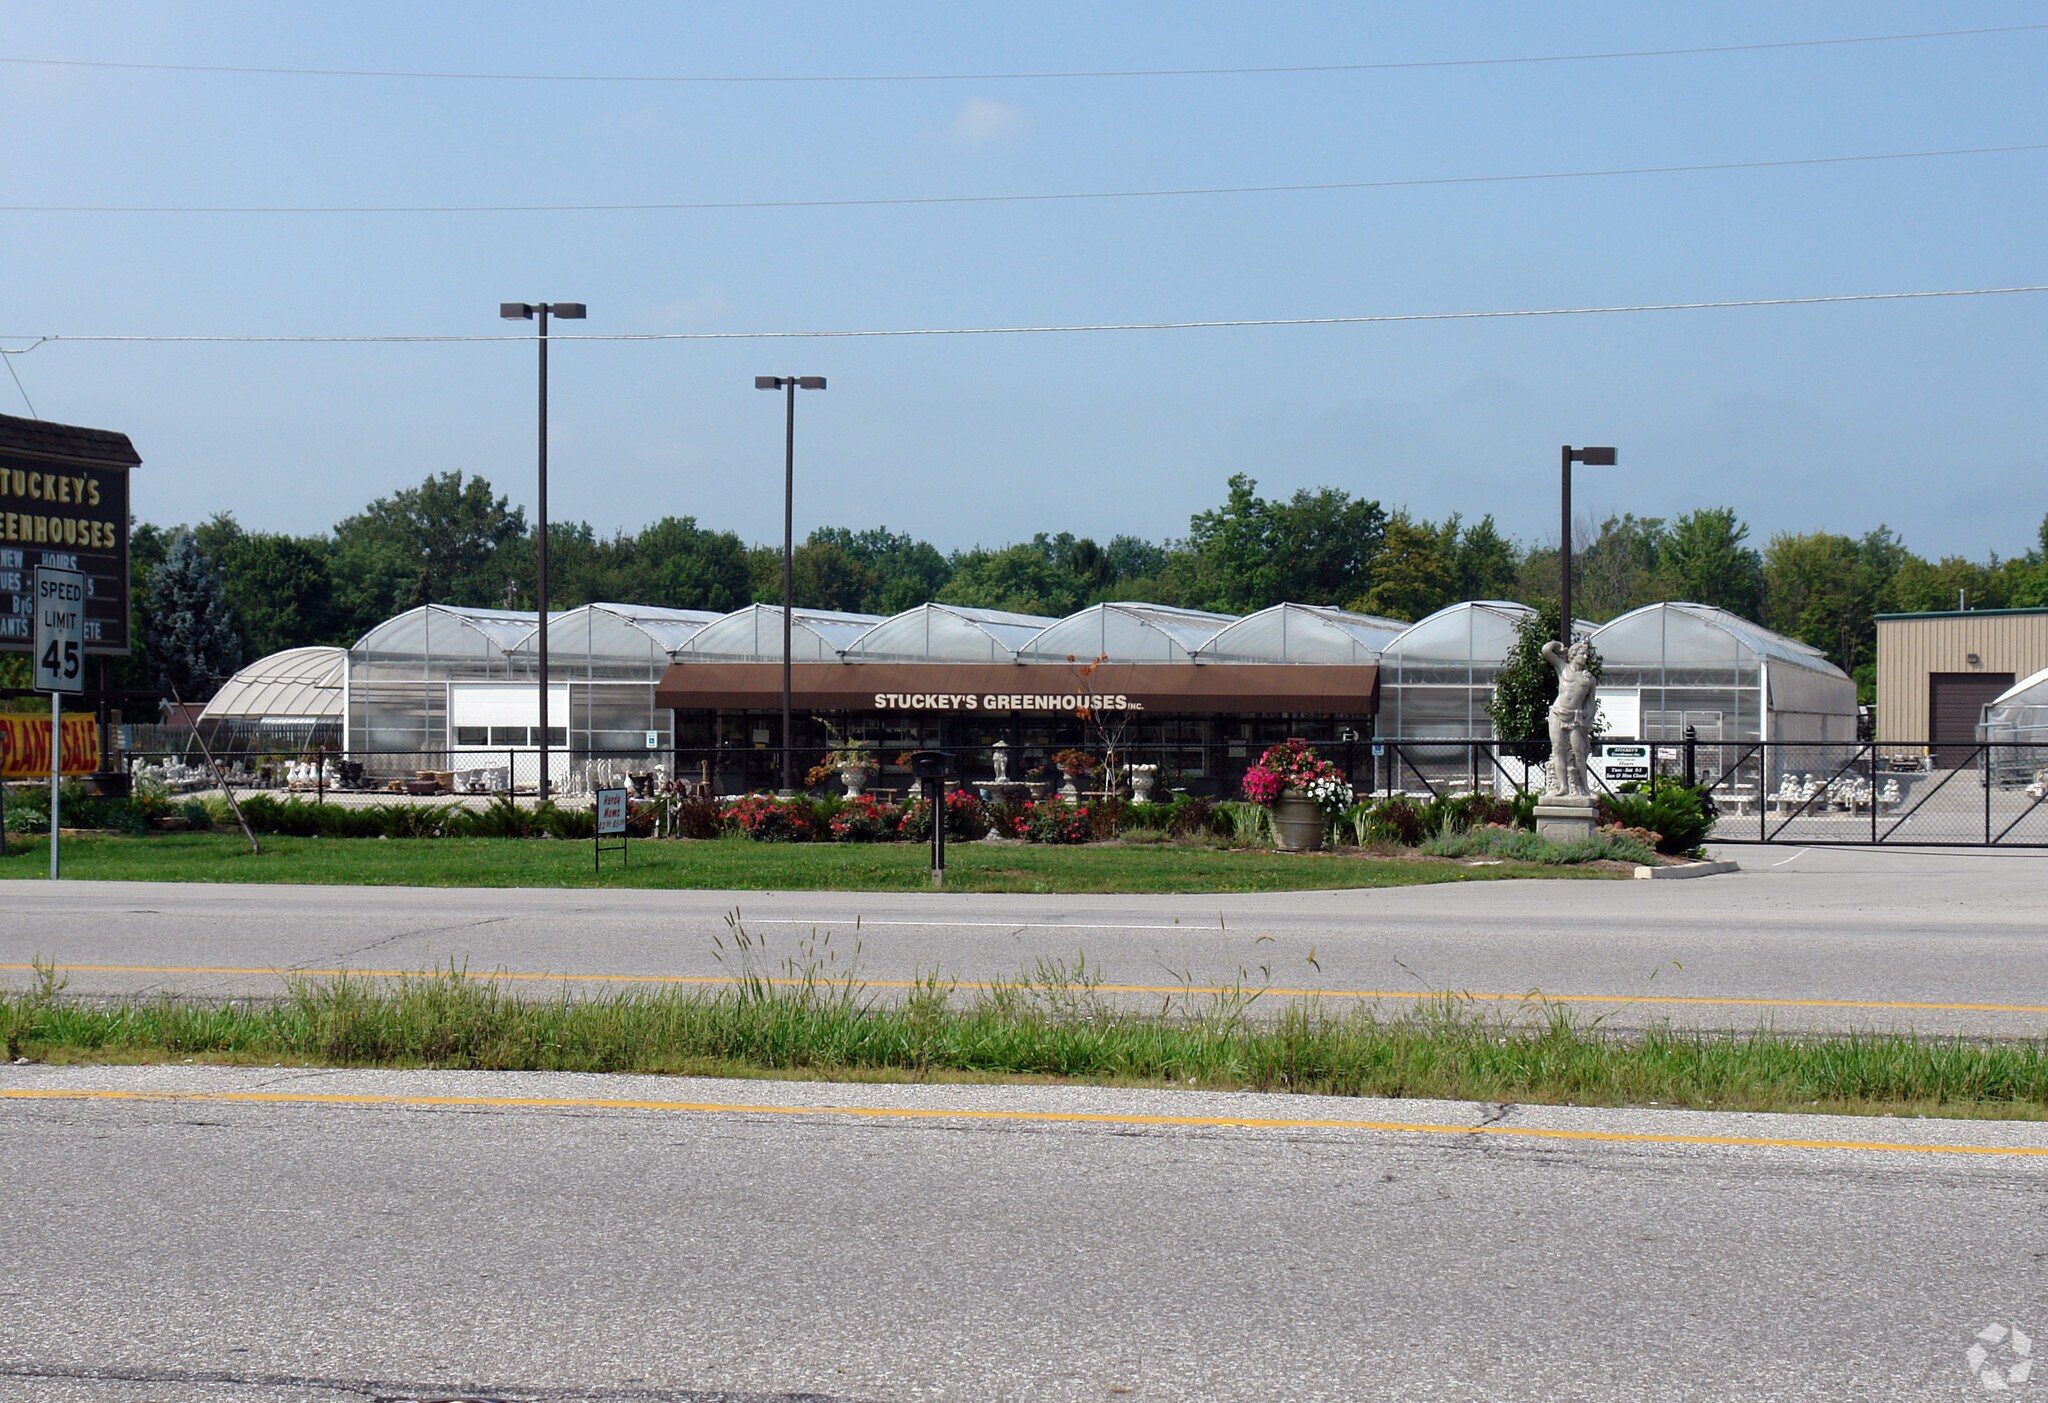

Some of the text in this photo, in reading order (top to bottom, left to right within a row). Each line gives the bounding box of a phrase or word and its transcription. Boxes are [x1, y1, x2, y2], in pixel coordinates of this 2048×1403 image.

[0, 549, 77, 570] NEW HOURS
[40, 580, 81, 602] SPEED
[45, 610, 76, 630] LIMIT
[41, 640, 79, 680] 45
[874, 693, 1144, 710] STUCKEY'S GREENHOUSES INC.
[60, 720, 97, 772] SALE
